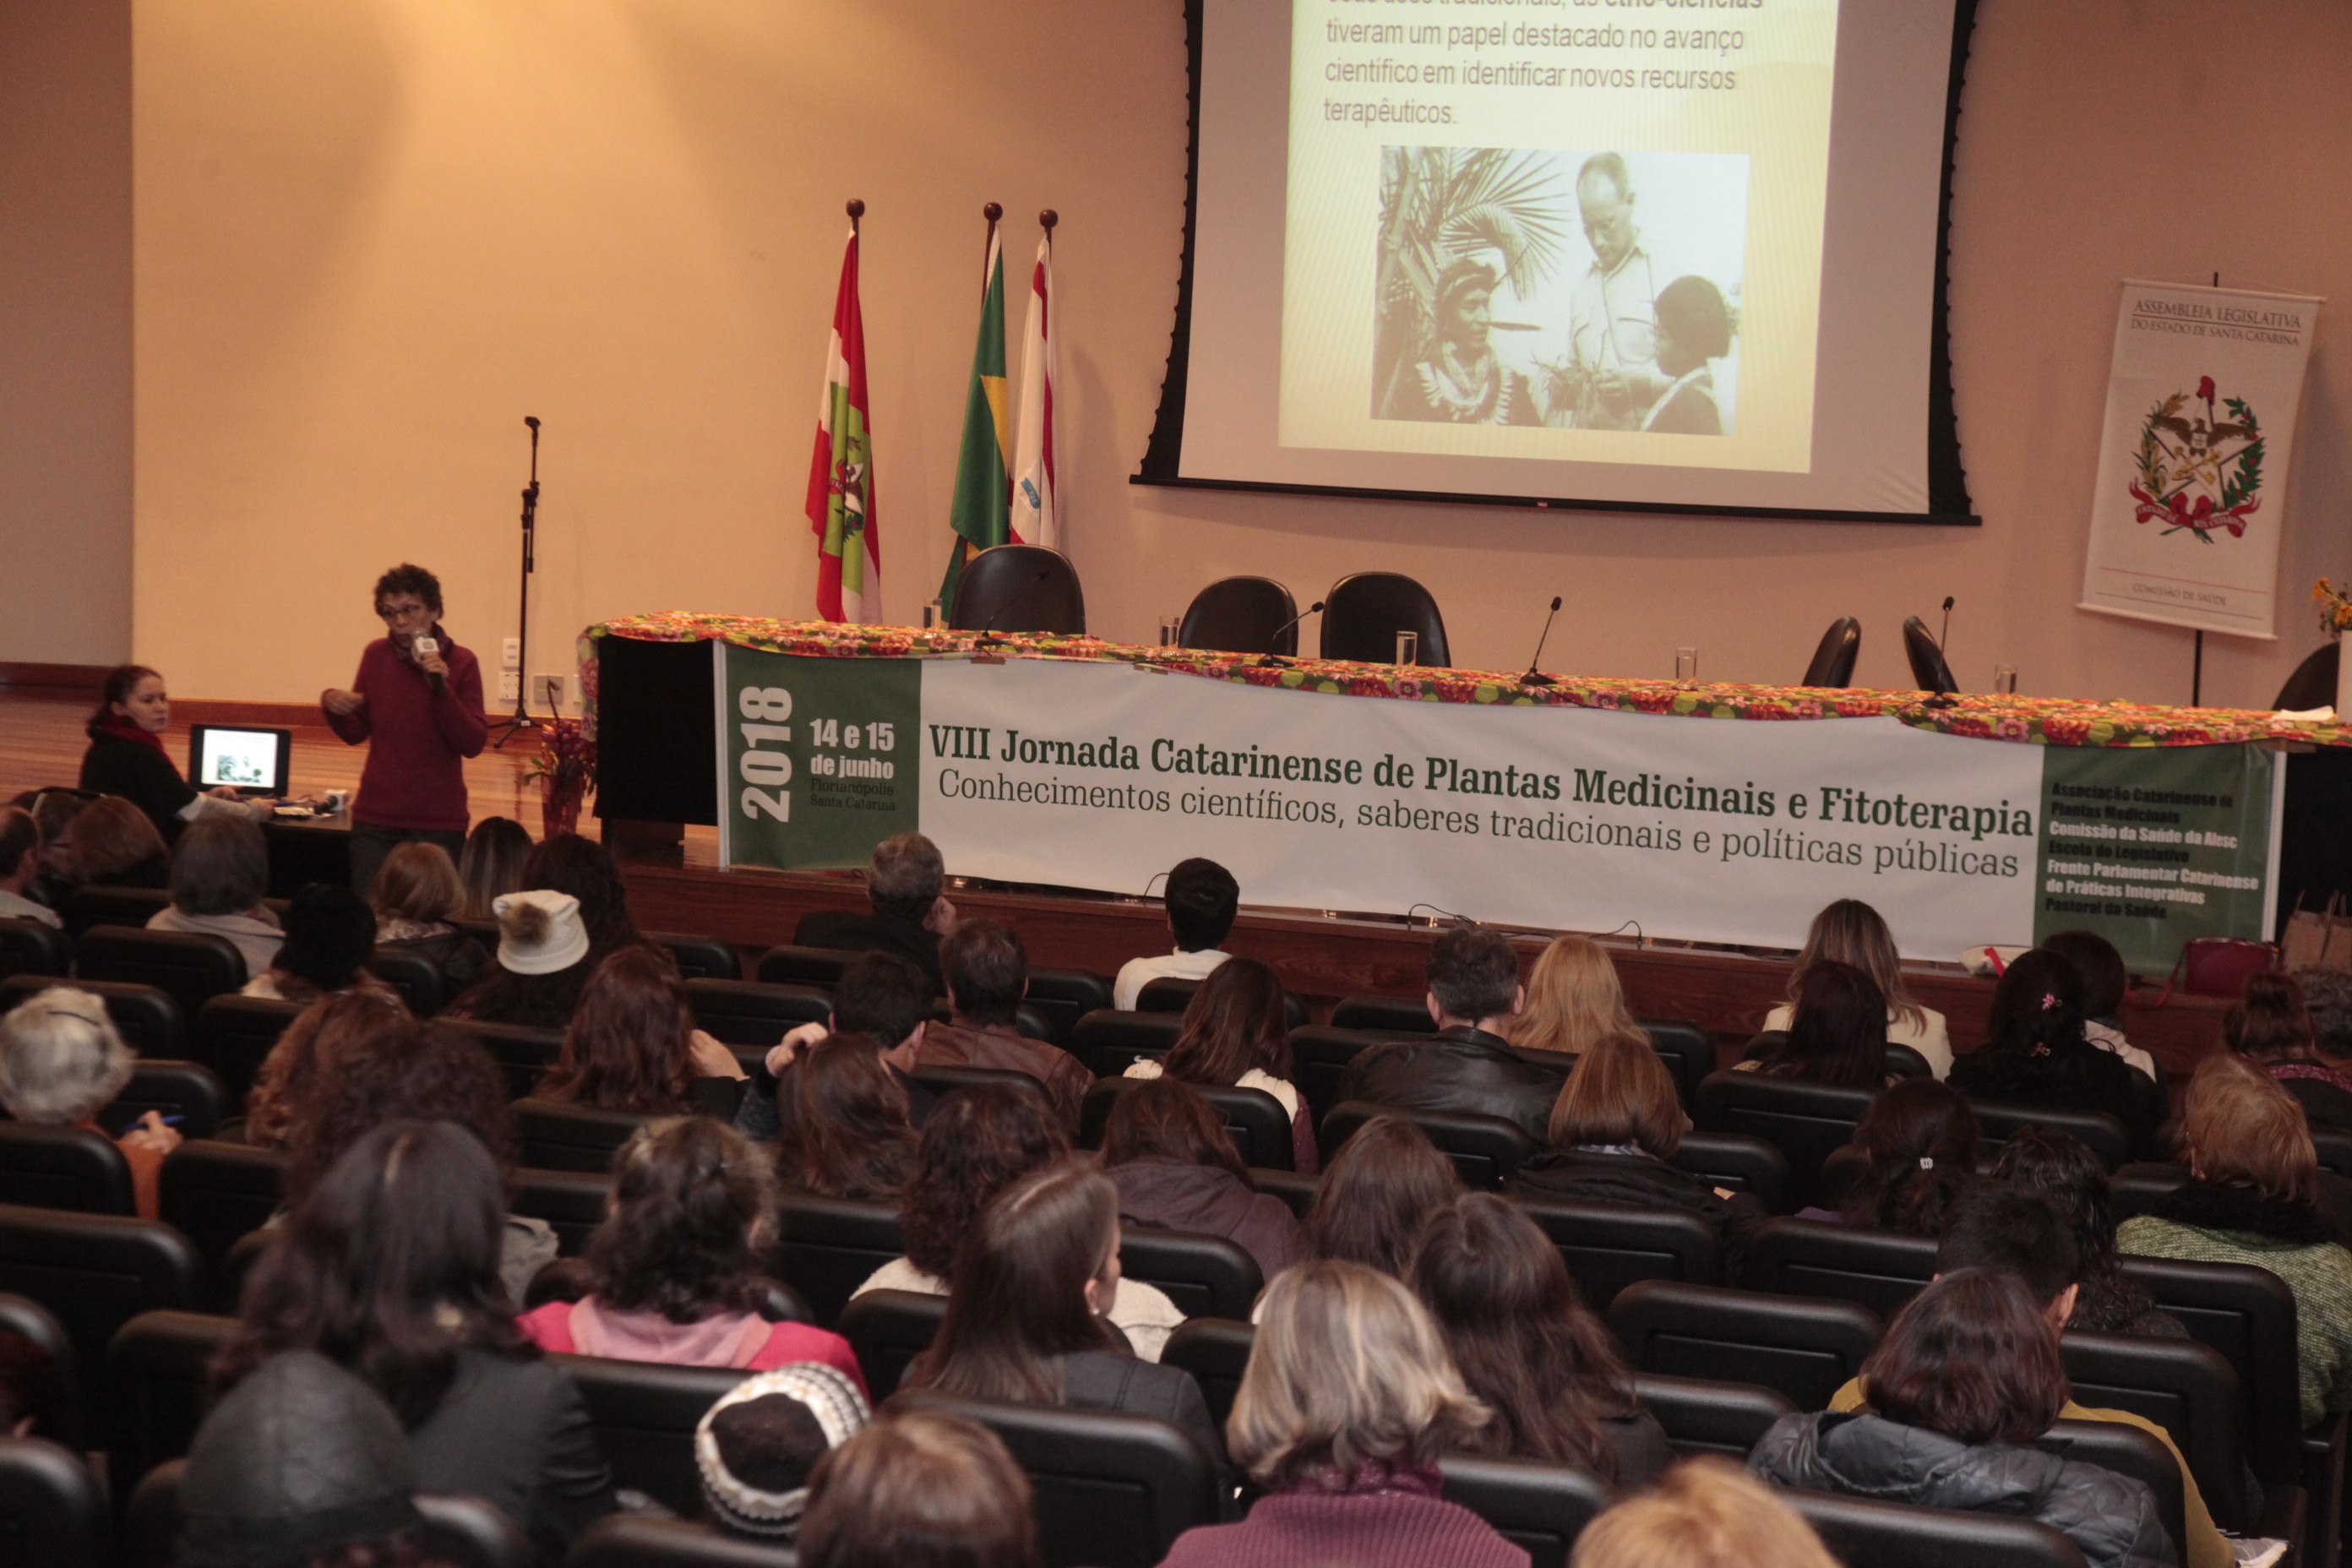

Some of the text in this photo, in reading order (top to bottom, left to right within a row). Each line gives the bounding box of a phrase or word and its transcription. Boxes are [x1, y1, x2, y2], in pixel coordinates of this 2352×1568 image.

[1326, 18, 1744, 57] tiveram um papel destacado no avanço
[1325, 57, 1735, 90] científico em identificar novos recursos
[1324, 97, 1456, 128] terapêuticos.
[2134, 300, 2301, 329] ASSEMBLEIA LEGISLATIVA
[2131, 318, 2299, 346] DO ESTADO DE SANTA CATARINA
[2181, 590, 2194, 601] DE
[809, 719, 895, 751] 14 e 15
[739, 686, 792, 823] 2018
[810, 754, 894, 779] de junho
[811, 778, 894, 796] Florianópolis
[928, 724, 2034, 841] VIII Jornada Catarinense de Plantas Medicinais e Fitoterapia
[2052, 782, 2130, 802] Associação
[2134, 788, 2216, 806] Catarinense
[810, 794, 895, 811] Santa Catarina
[2051, 802, 2180, 824] Plantas Medicinais
[939, 768, 2018, 877] Conhecimentos científicos, saberes tradicionais e políticas públicas
[2050, 821, 2238, 848] Comissão da Saúde da Alesc
[2049, 841, 2092, 857] Escola
[2115, 845, 2189, 863] Legislativo
[2047, 859, 2259, 890] Frente Parlamentar Catarinense
[2046, 879, 2205, 905] de Práticas Integrativas
[2045, 898, 2167, 918] Pastoral da Saúde
